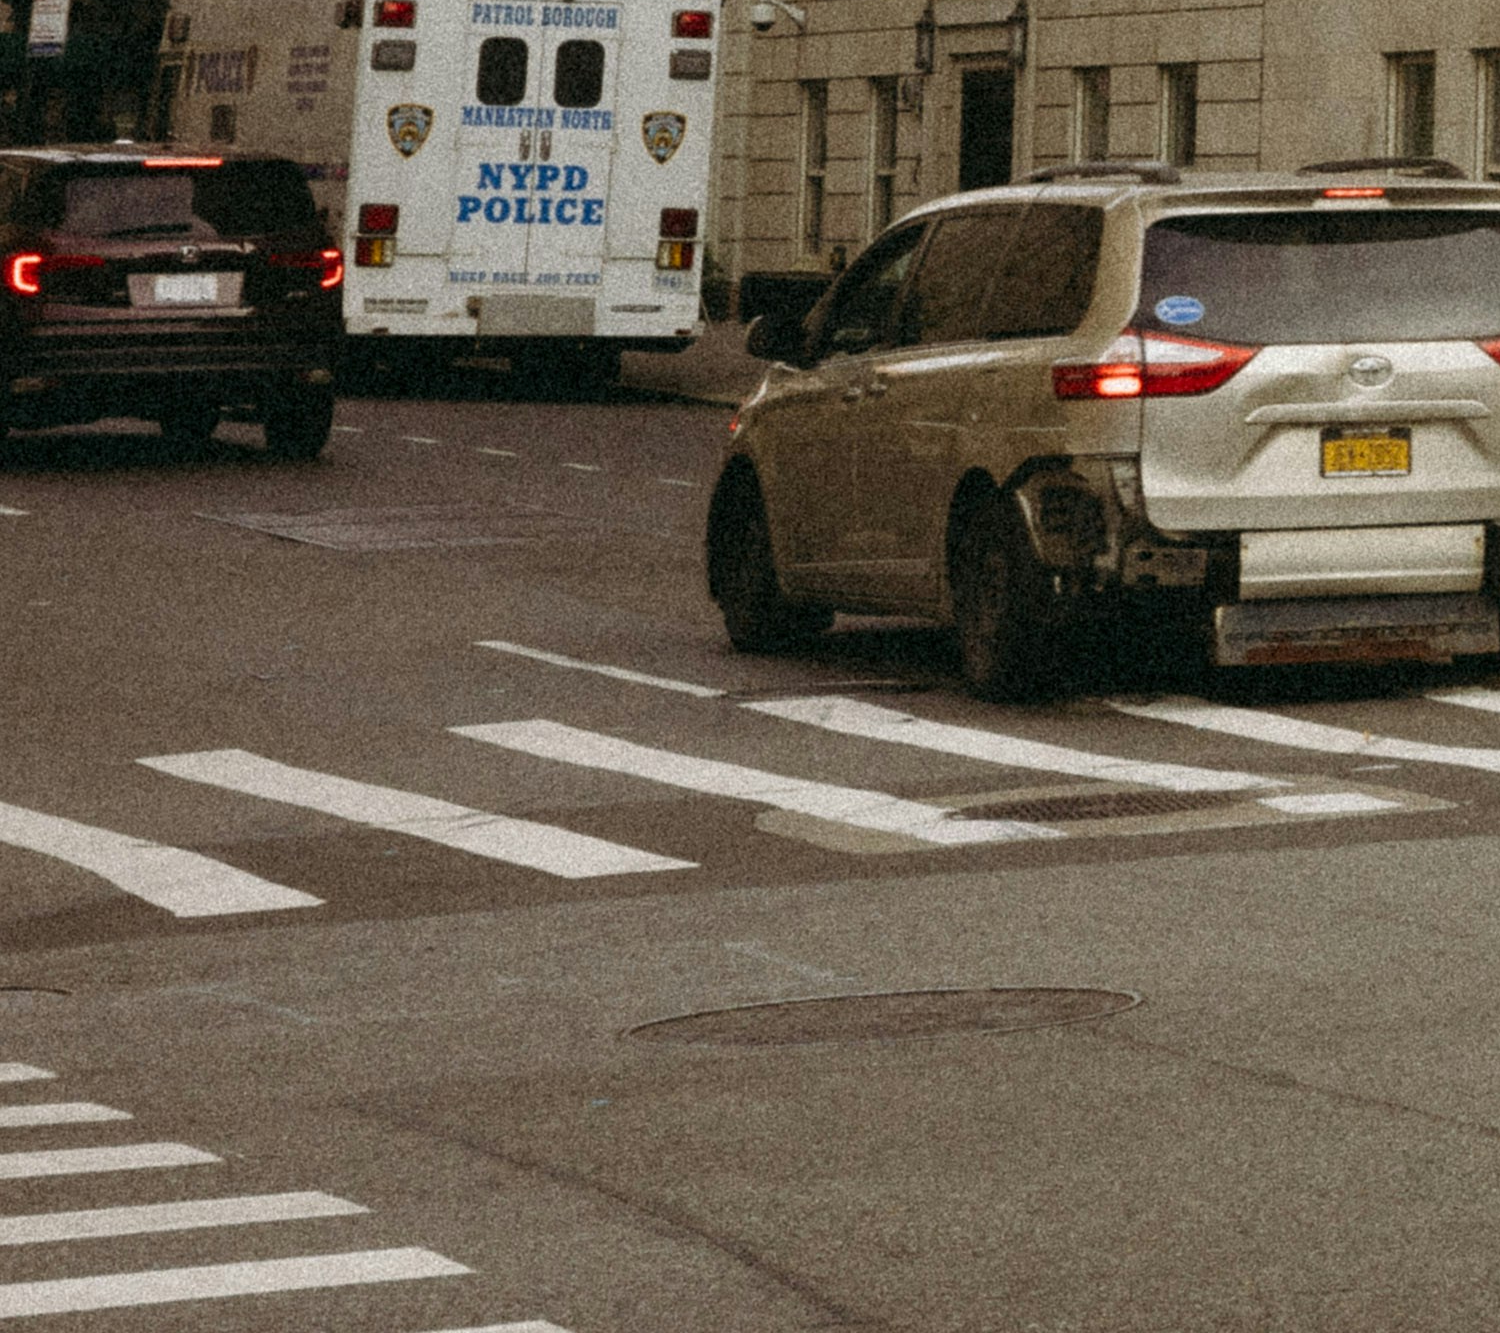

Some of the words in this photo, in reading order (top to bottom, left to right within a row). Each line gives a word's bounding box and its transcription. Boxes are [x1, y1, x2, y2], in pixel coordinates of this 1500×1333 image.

[472, 4, 534, 26] PATROL
[541, 6, 618, 29] BOROUGH
[462, 106, 555, 128] MANHATTAN
[561, 110, 612, 130] NORTH
[477, 163, 589, 192] NYPD
[456, 195, 604, 226] POLICE
